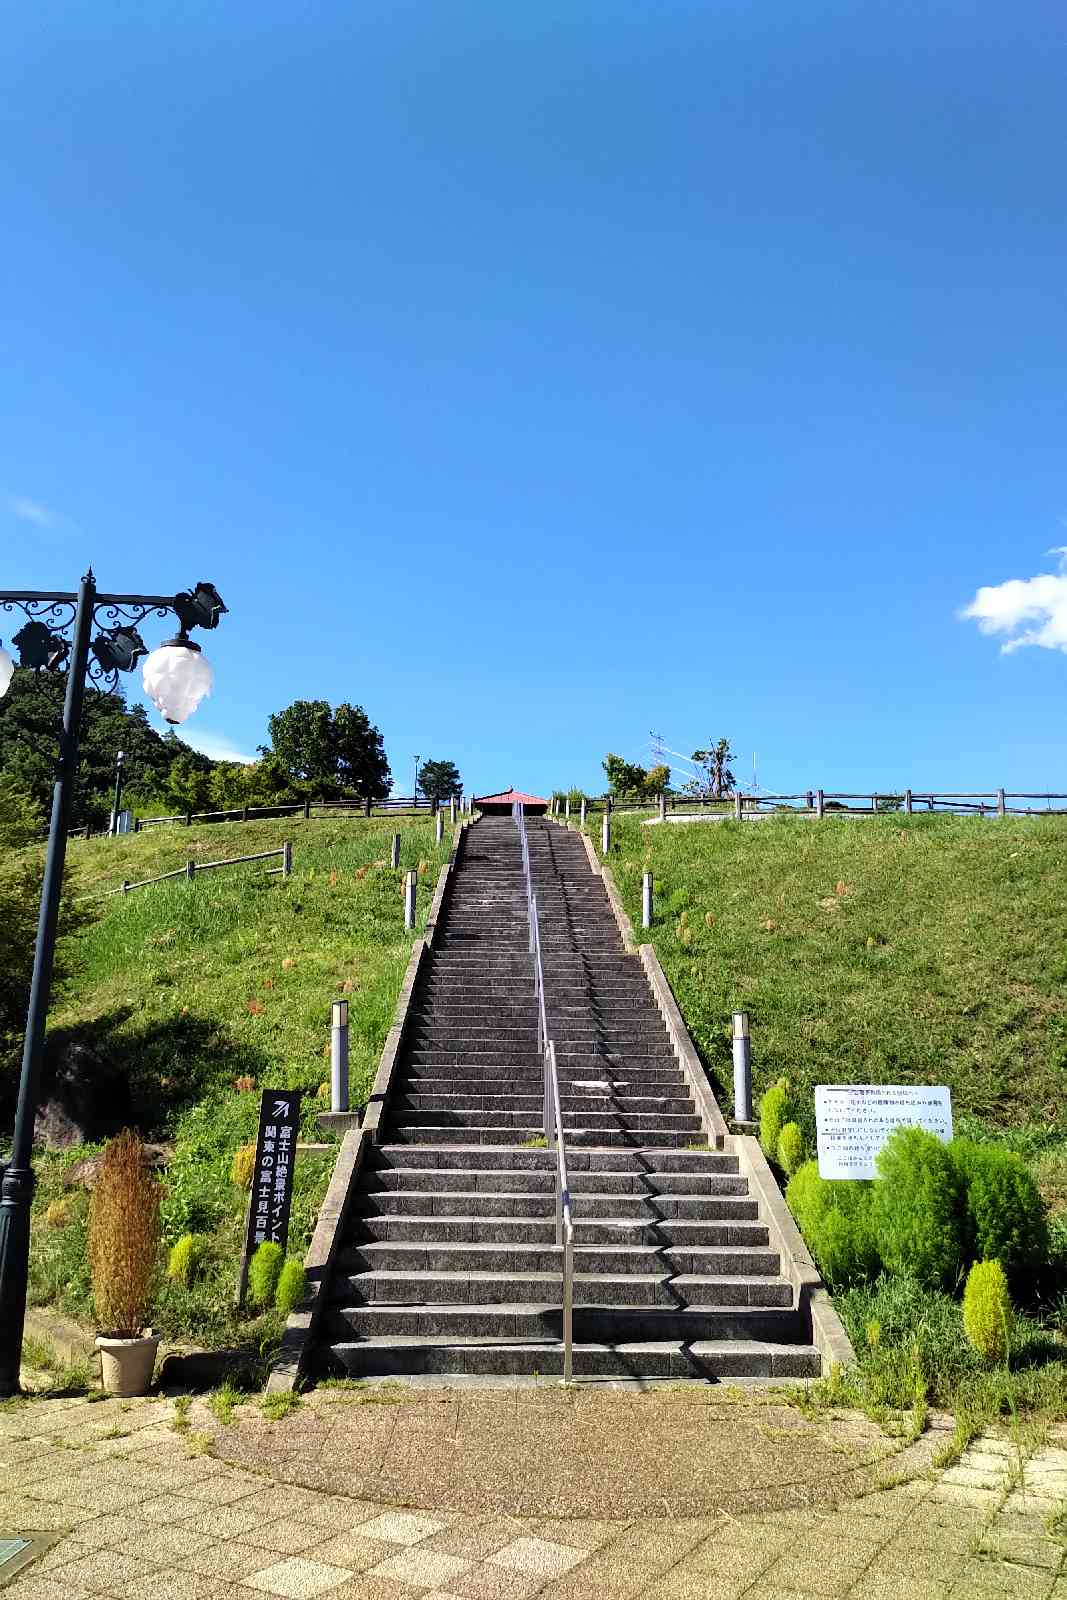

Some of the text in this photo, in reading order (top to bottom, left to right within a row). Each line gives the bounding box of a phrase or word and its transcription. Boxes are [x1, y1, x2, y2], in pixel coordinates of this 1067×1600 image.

[271, 1125, 293, 1244] 富士山絶景ポイント
